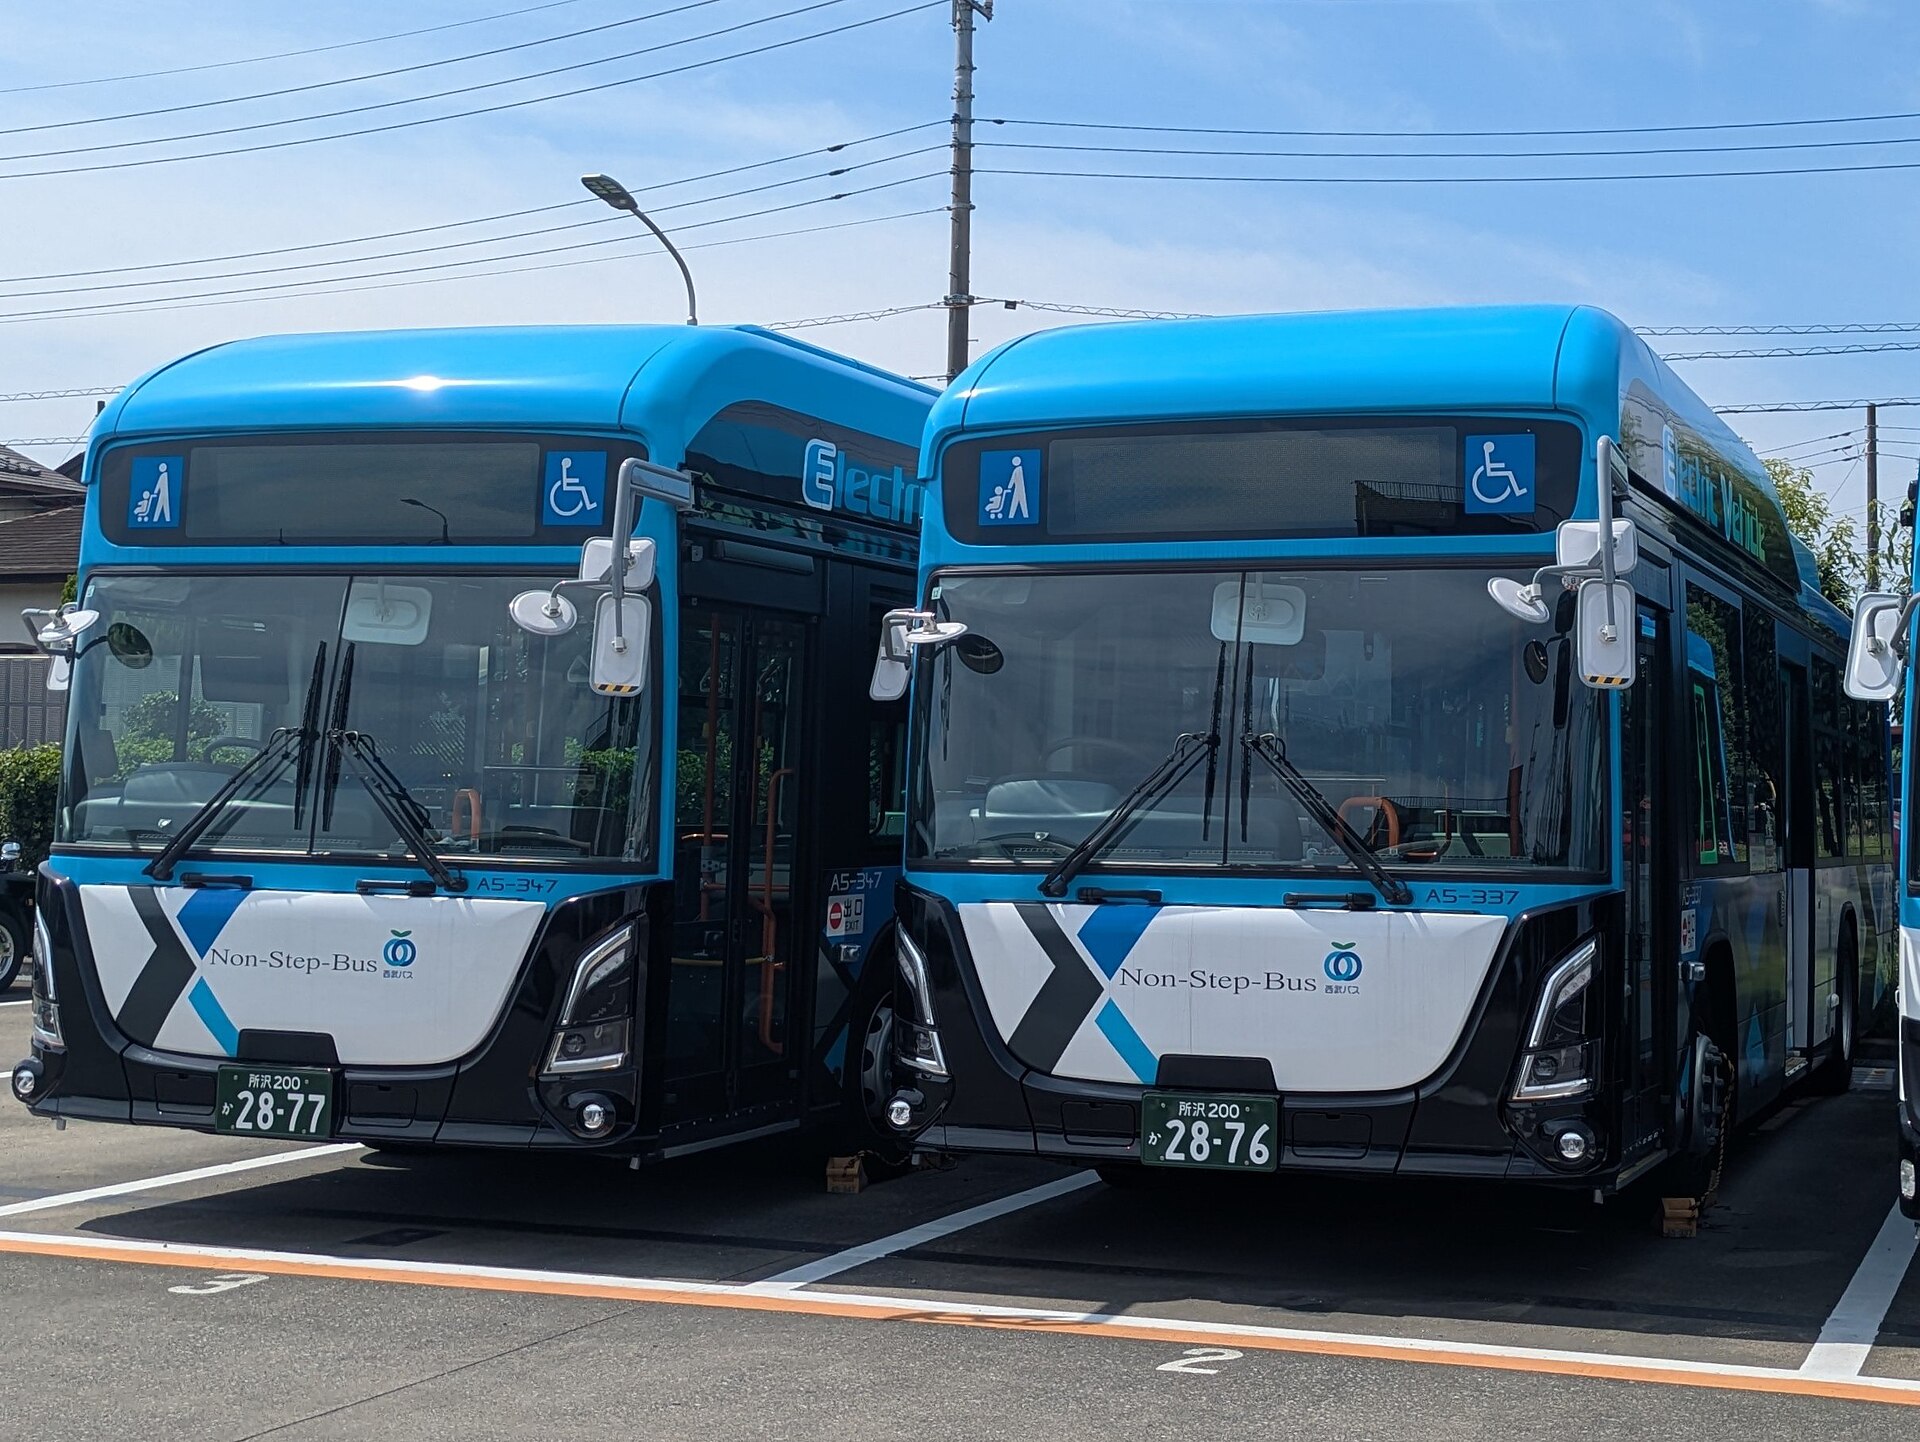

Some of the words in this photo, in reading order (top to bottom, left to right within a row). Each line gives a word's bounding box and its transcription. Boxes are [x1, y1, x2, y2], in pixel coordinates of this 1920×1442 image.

[802, 438, 924, 525] Electr
[1720, 472, 1767, 563] Vehicle
[476, 877, 559, 894] A5-347
[830, 871, 883, 892] A5-347
[843, 898, 863, 918] 出口
[1425, 888, 1520, 905] A5-337
[210, 948, 378, 975] Non-Step-Bus
[383, 970, 414, 979] 西武バス
[1119, 968, 1317, 995] Non-Step-Bus
[1324, 984, 1360, 995] 西武バス
[221, 1102, 234, 1116] か
[235, 1090, 326, 1134] 28-77
[1148, 1131, 1162, 1146] か
[1165, 1119, 1270, 1165] 28-76
[167, 1273, 270, 1295] 3
[1155, 1347, 1244, 1374] 2
